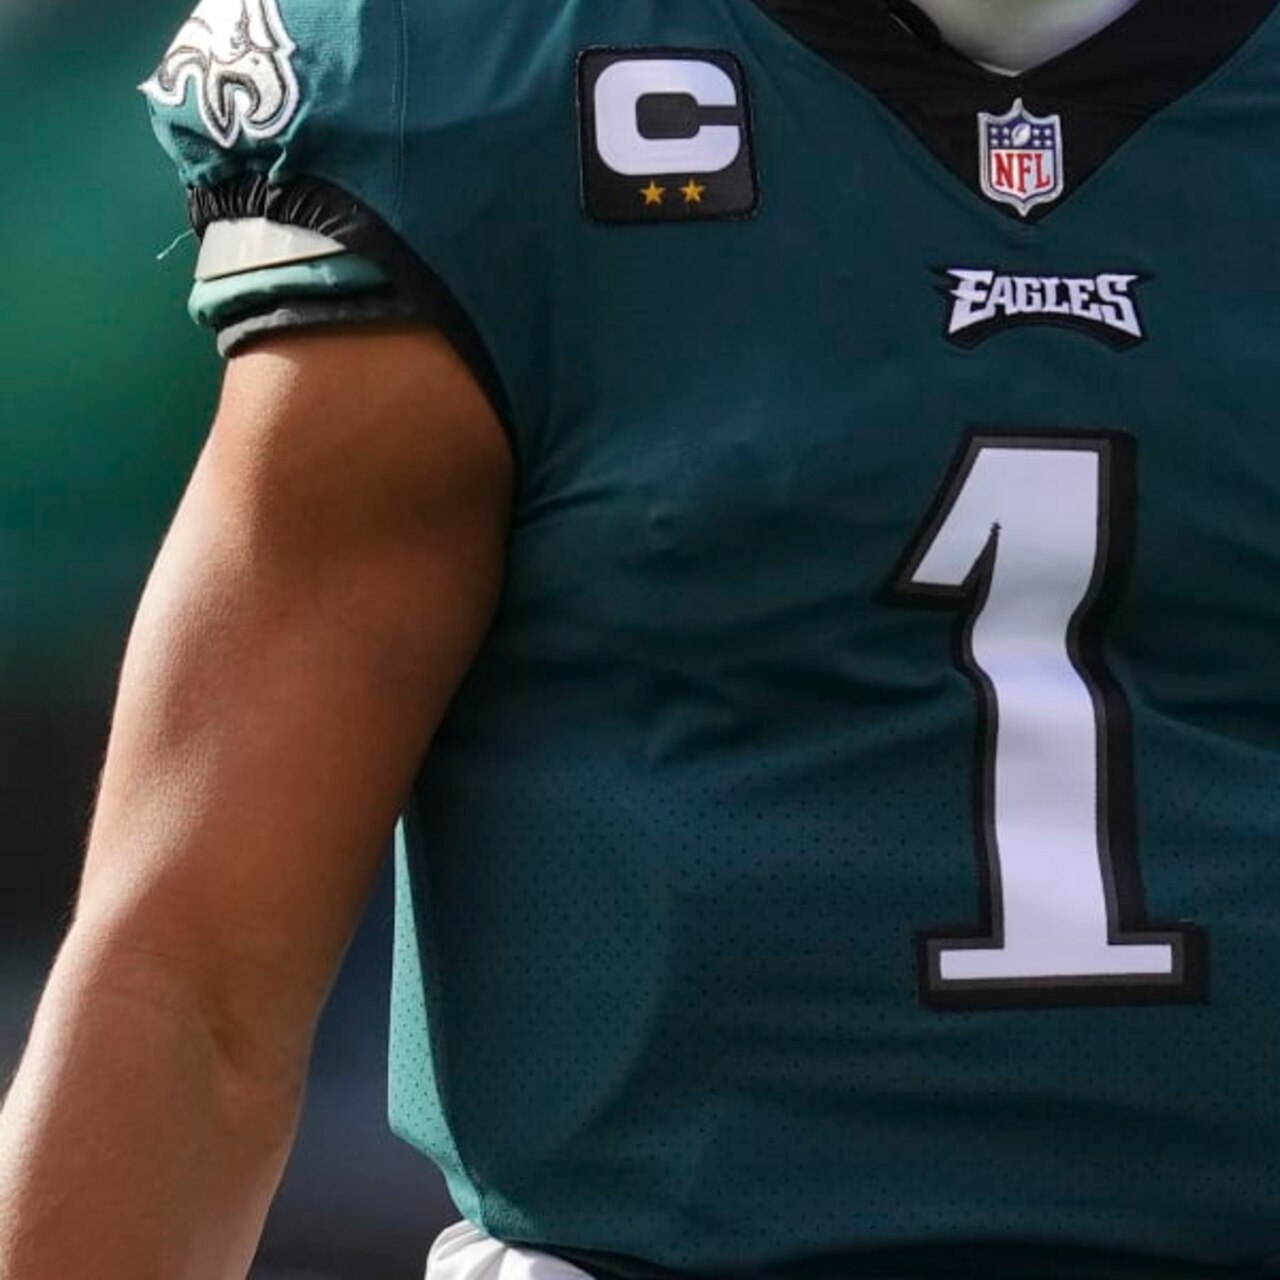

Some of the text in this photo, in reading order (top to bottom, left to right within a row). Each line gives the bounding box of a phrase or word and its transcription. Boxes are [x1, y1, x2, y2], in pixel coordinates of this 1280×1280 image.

[594, 58, 742, 176] C
[990, 150, 1052, 195] NFL
[946, 267, 1145, 340] EAGLES
[905, 442, 1178, 986] 1
